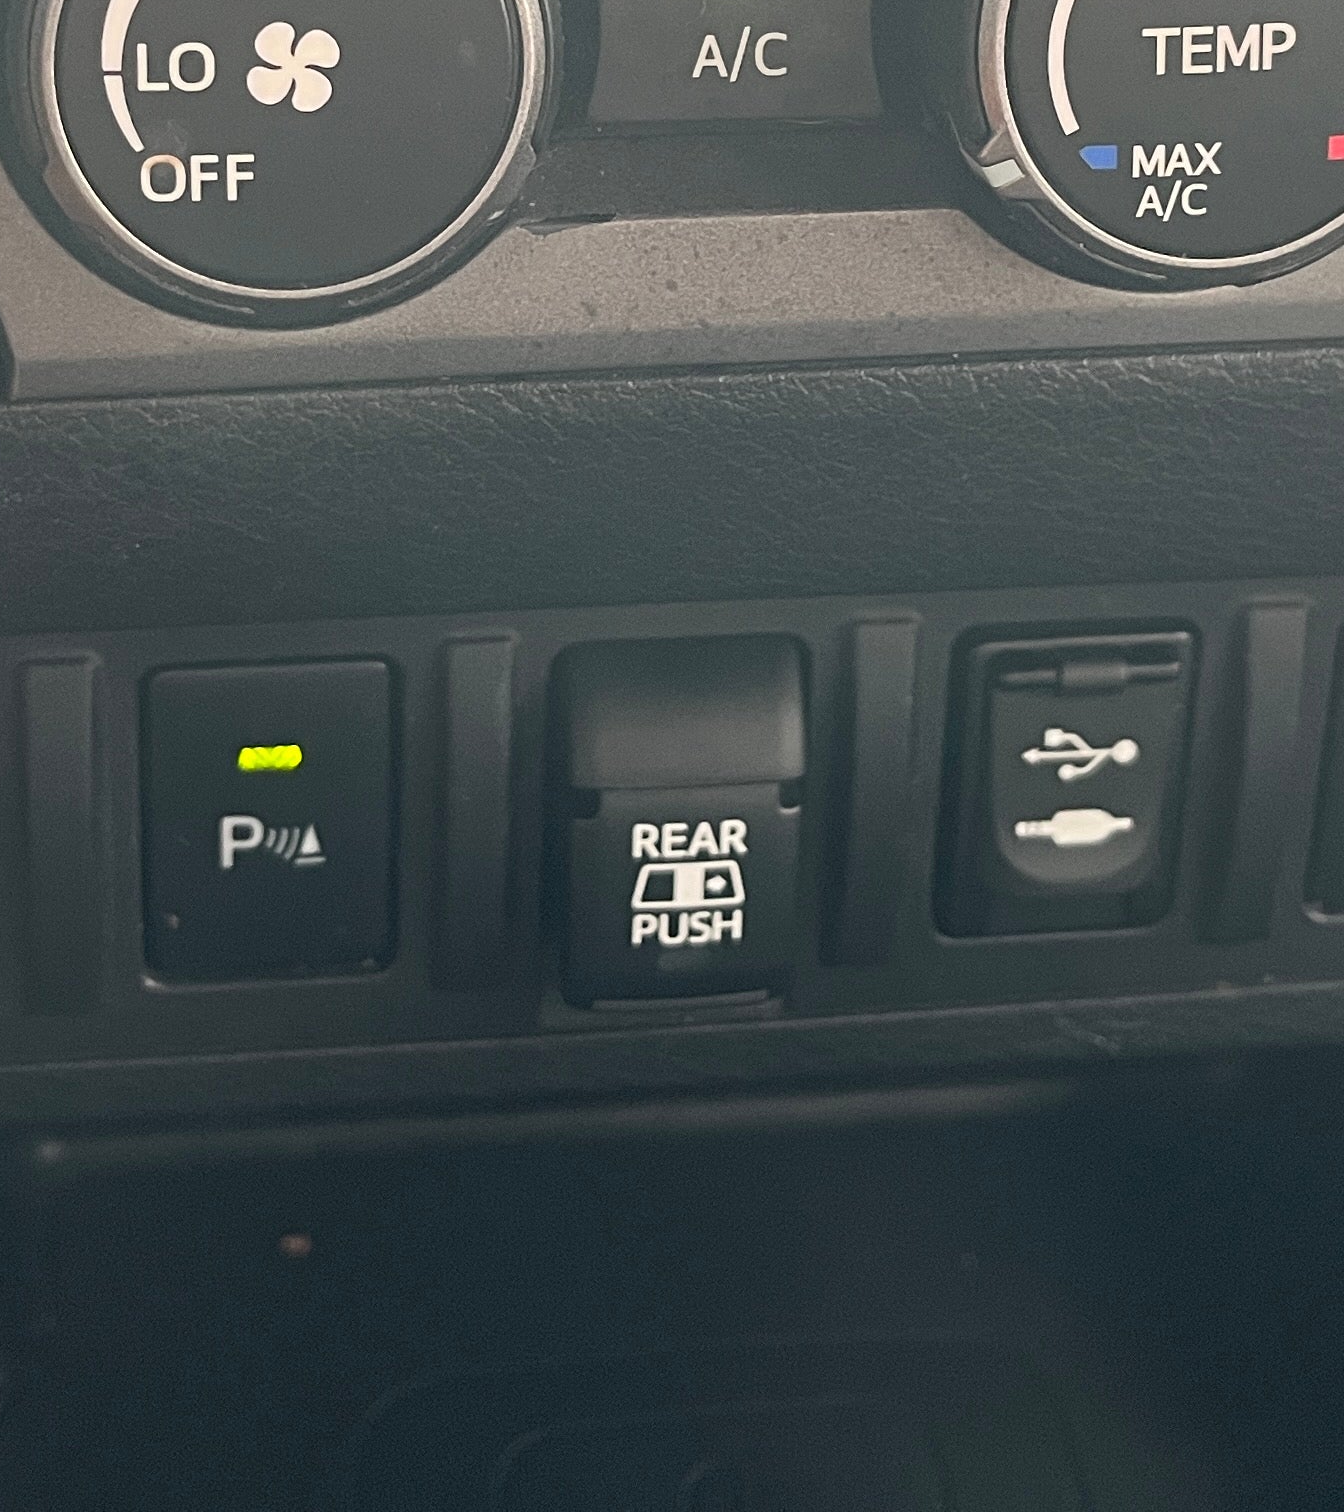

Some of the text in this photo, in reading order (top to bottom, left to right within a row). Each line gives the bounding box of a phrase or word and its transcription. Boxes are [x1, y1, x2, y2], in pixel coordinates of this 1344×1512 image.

[136, 42, 216, 92] LO
[692, 26, 788, 83] A/C
[1142, 22, 1297, 75] TEMP
[140, 154, 255, 202] OFF
[1132, 142, 1223, 178] MAX
[1135, 180, 1208, 222] A/C
[218, 815, 264, 869] P
[631, 819, 748, 859] REAR
[631, 909, 744, 947] PUSH
